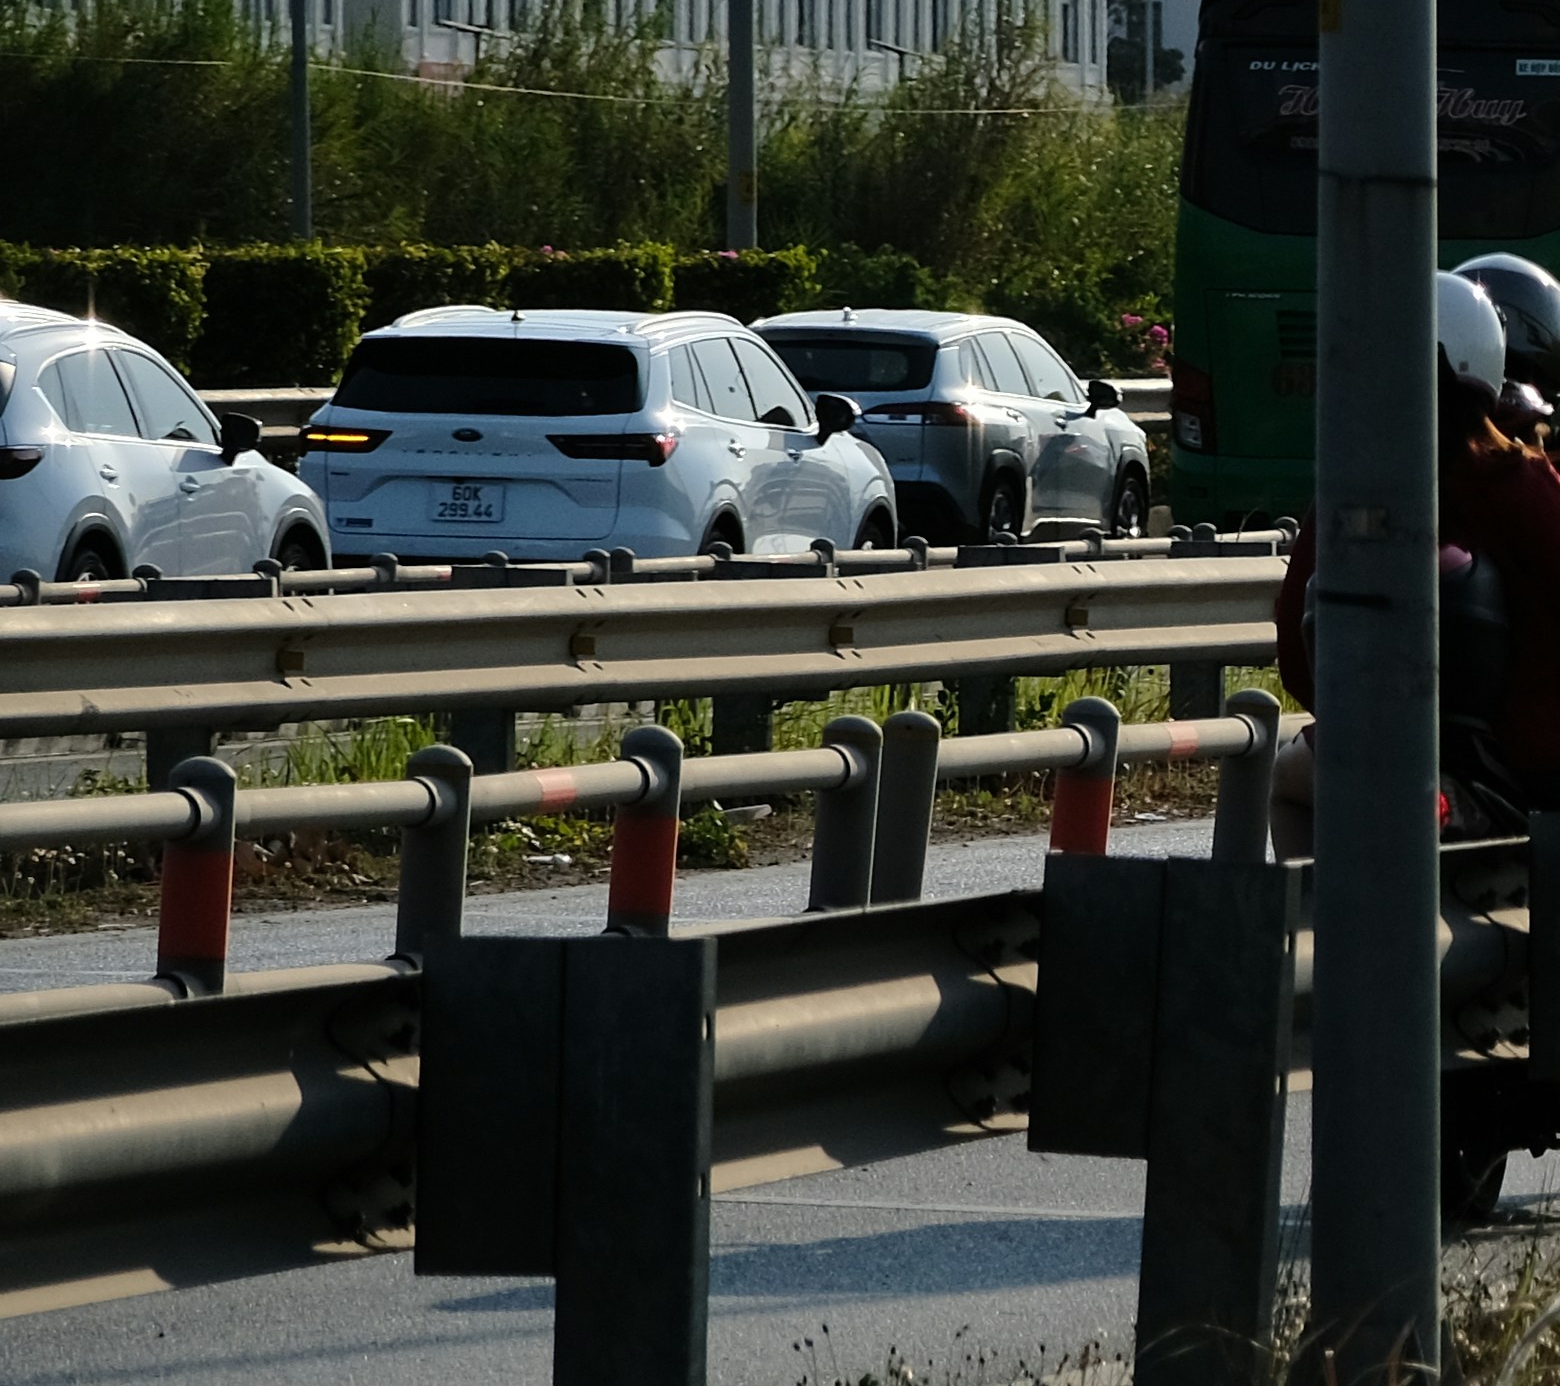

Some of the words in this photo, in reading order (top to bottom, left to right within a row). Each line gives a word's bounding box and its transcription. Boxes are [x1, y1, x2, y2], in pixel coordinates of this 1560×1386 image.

[1249, 61, 1277, 70] DU
[452, 486, 483, 501] 60K
[437, 502, 493, 518] 299.44
